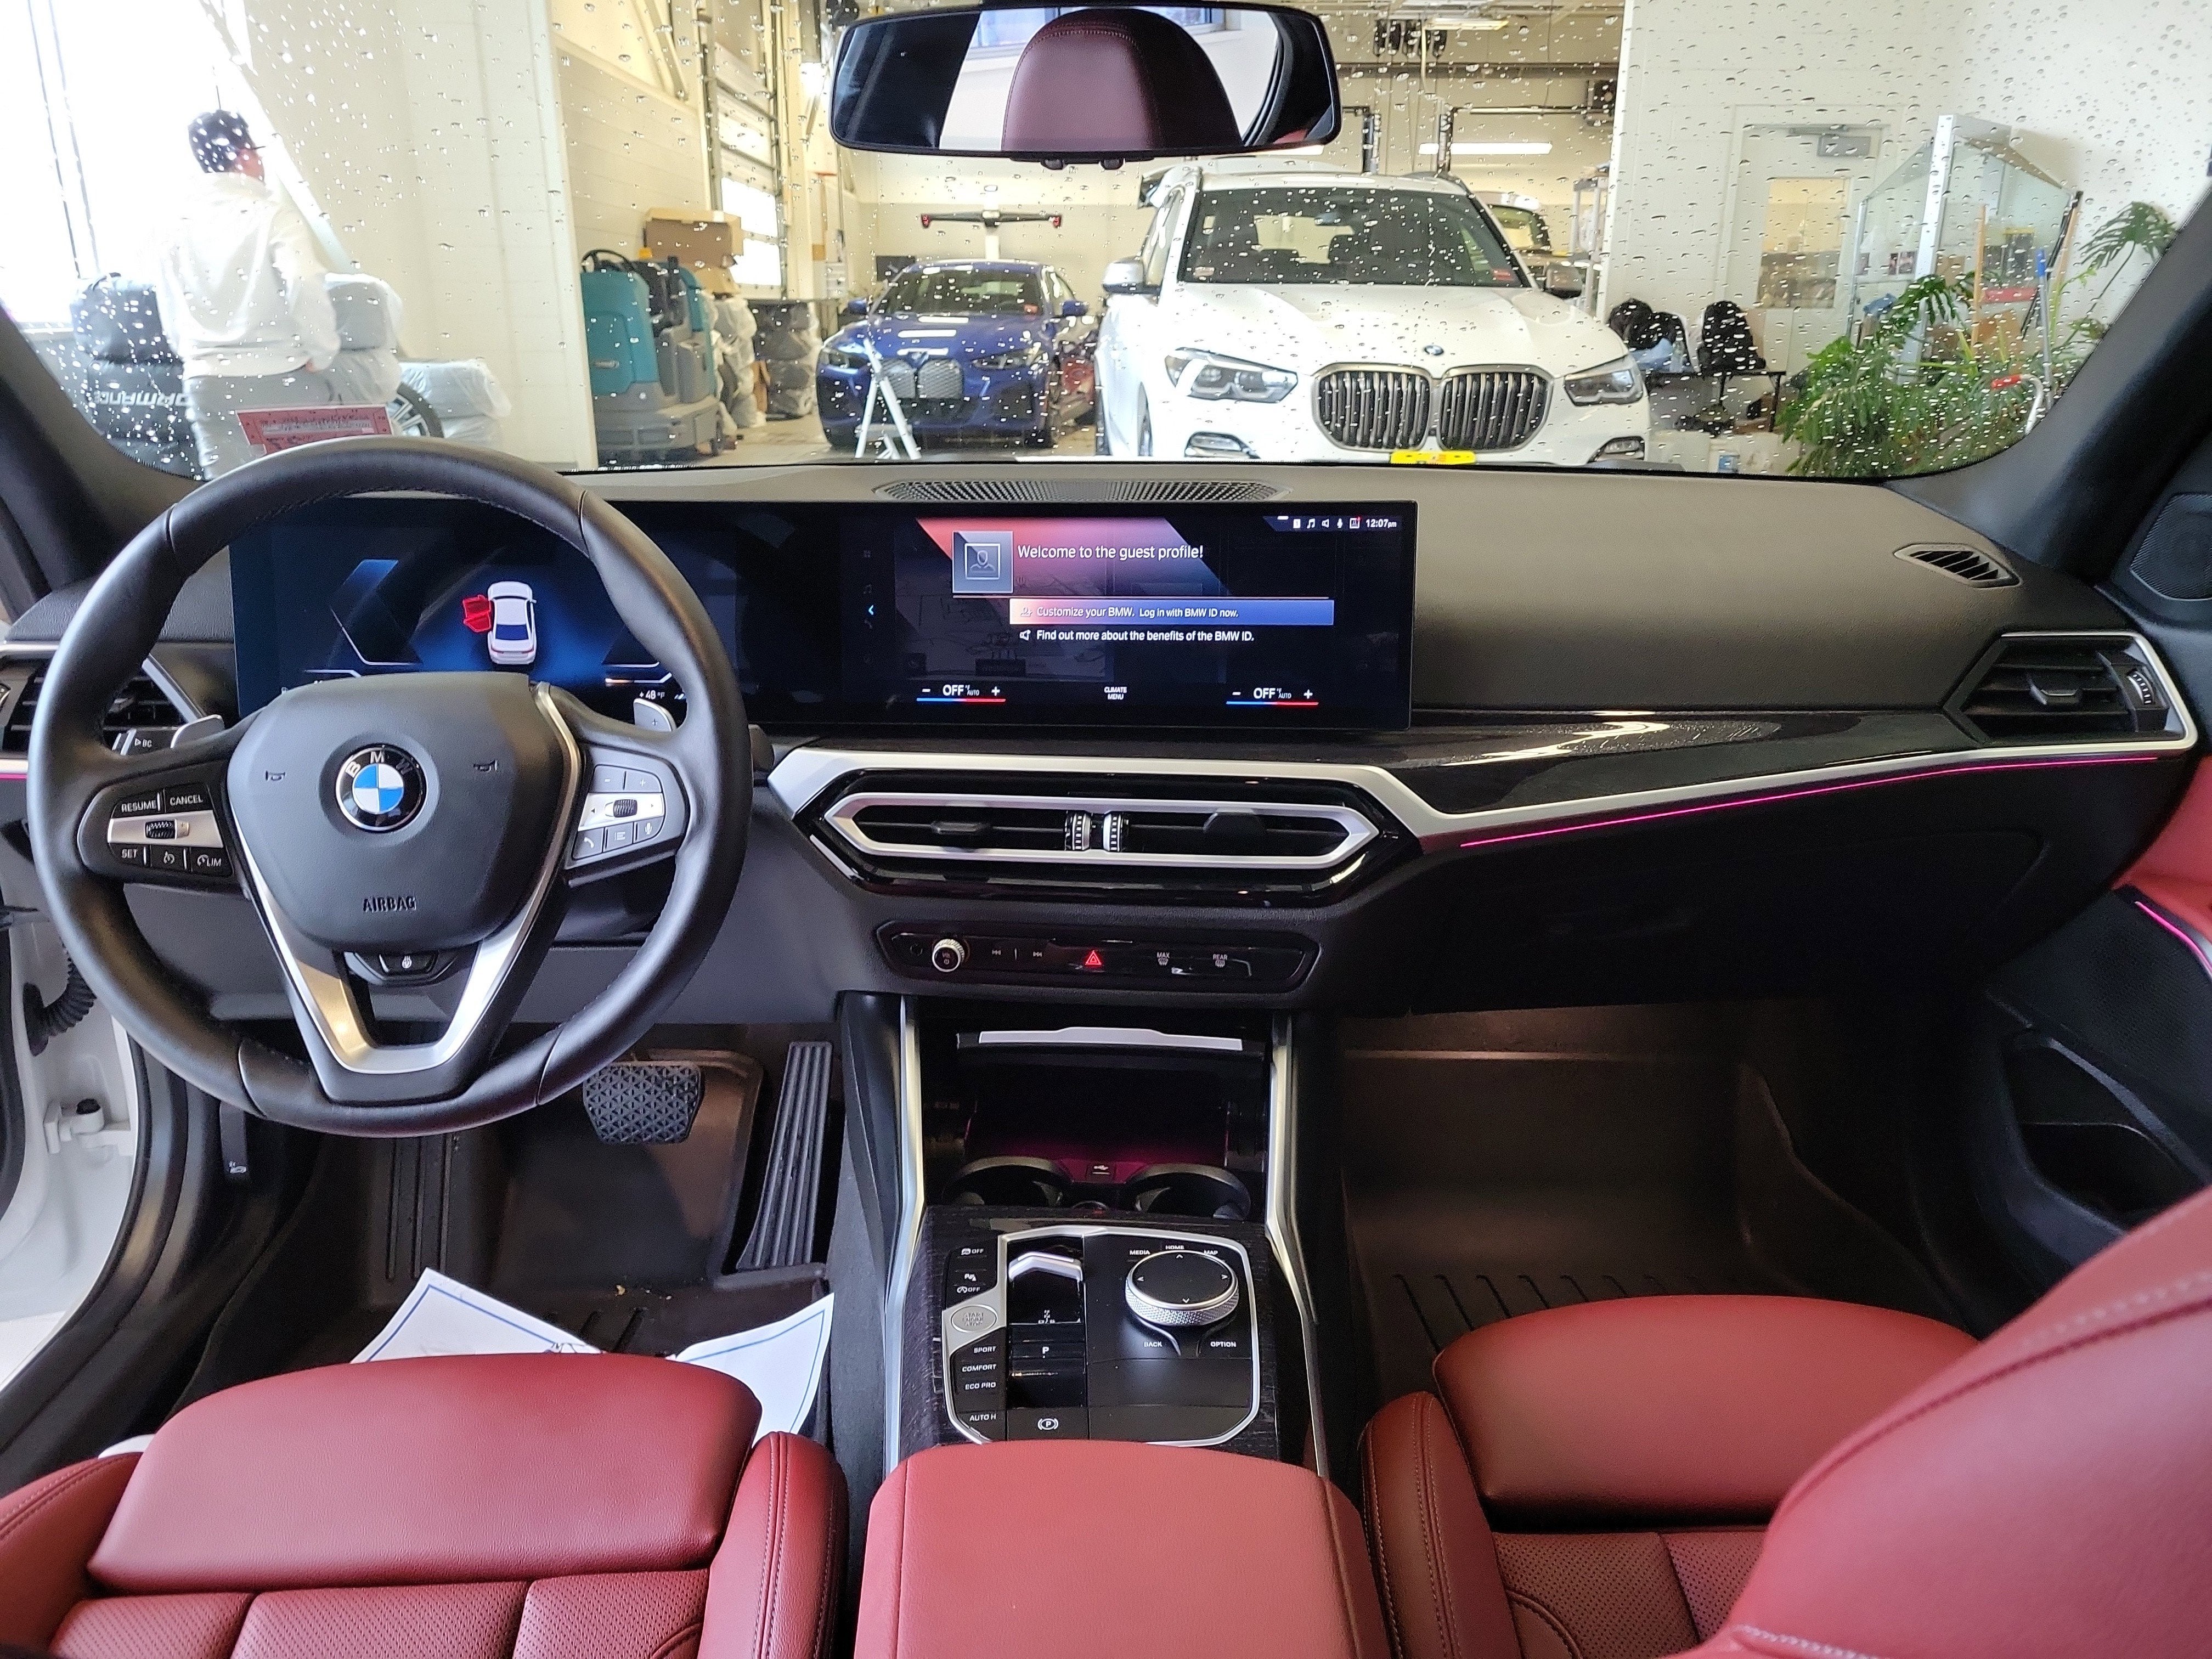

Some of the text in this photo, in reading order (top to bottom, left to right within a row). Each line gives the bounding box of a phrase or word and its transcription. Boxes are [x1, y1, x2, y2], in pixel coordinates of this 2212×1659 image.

[1018, 545, 1204, 561] Welcome to the guest profile!
[1036, 606, 1239, 619] Customize your BMW. Log in with BMW ID now.
[1036, 629, 1255, 641] Find out more about the benefits of the BMW ID.
[943, 684, 964, 696] OFF
[1253, 687, 1276, 699] OFF
[345, 751, 413, 778] BMW
[121, 794, 204, 813] RESUME CANCEL
[121, 849, 222, 867] SET LIM
[363, 895, 417, 913] AIRBAG
[962, 1364, 997, 1372] COMFORT
[969, 1414, 990, 1422] AUTO
